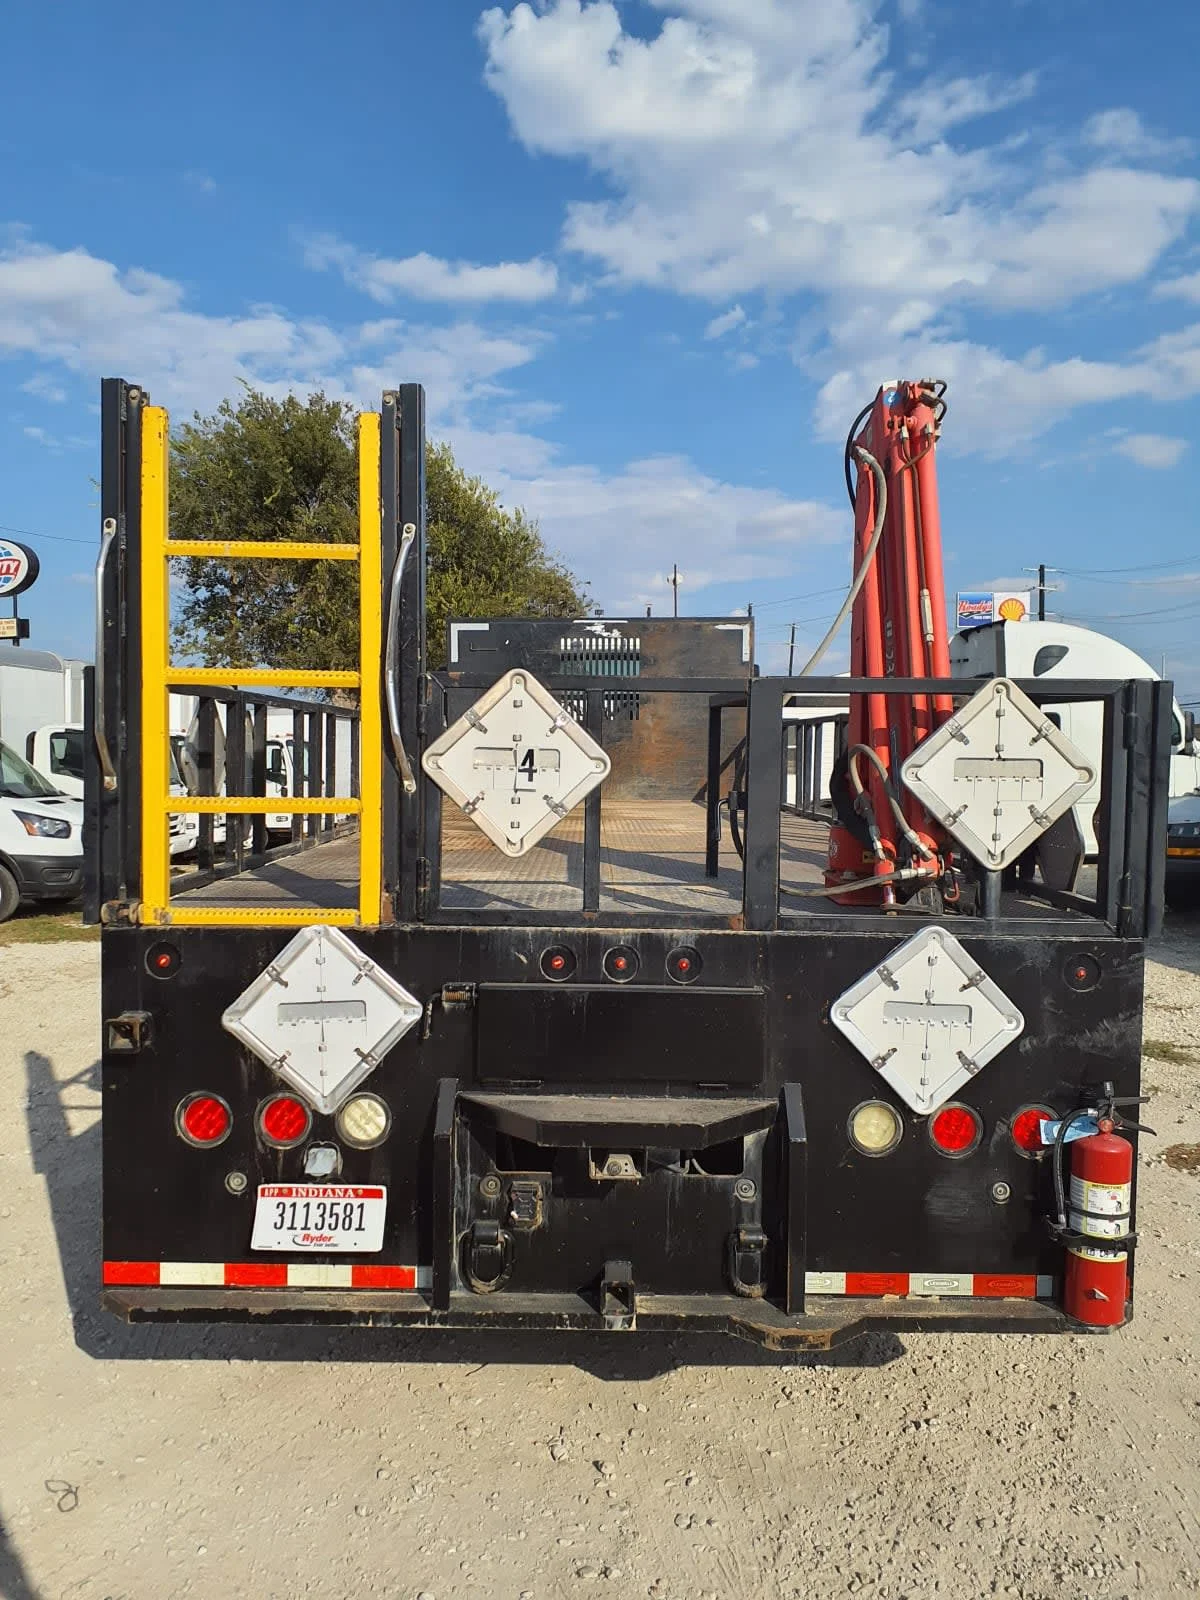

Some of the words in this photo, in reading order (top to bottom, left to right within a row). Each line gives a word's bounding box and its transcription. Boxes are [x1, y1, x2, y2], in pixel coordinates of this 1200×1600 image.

[518, 748, 538, 782] 4
[292, 1187, 356, 1198] INDIANA
[273, 1202, 365, 1231] 3113581
[301, 1233, 334, 1244] Ryder
